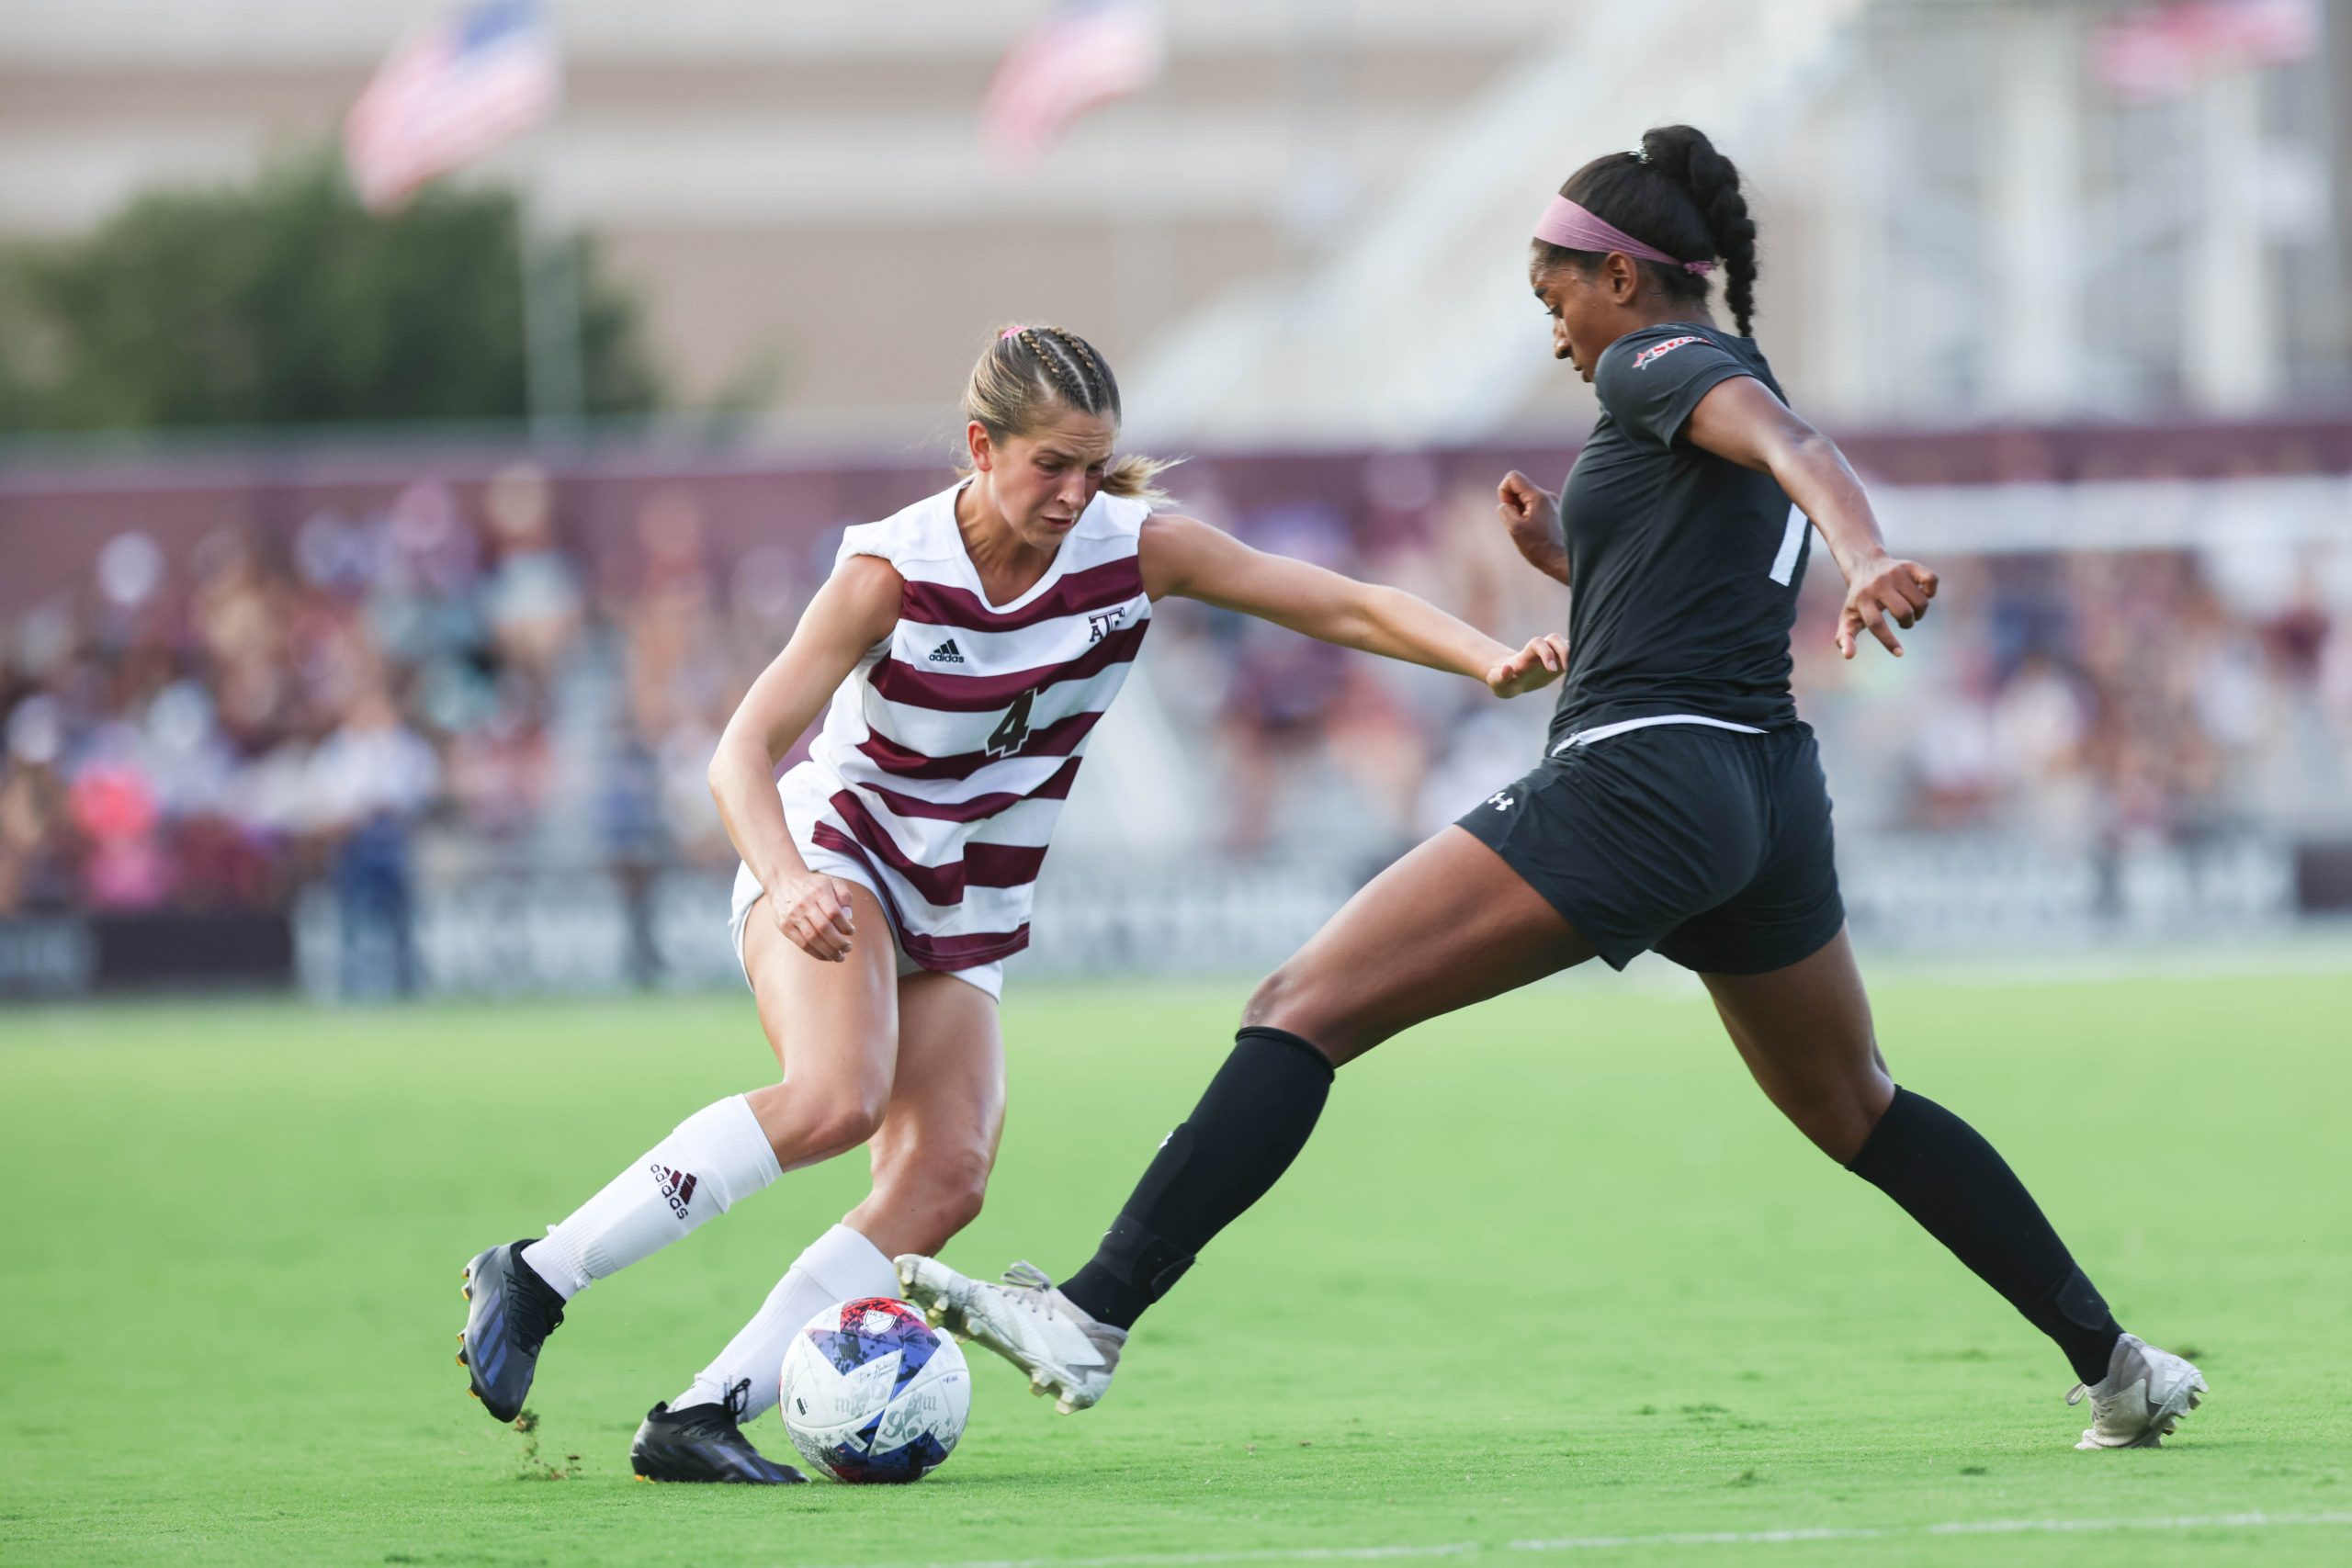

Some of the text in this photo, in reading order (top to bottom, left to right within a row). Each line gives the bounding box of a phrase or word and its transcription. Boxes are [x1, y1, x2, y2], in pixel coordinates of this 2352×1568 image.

[929, 653, 965, 663] adidas
[986, 687, 1038, 759] 4
[650, 1164, 689, 1220] adidas
